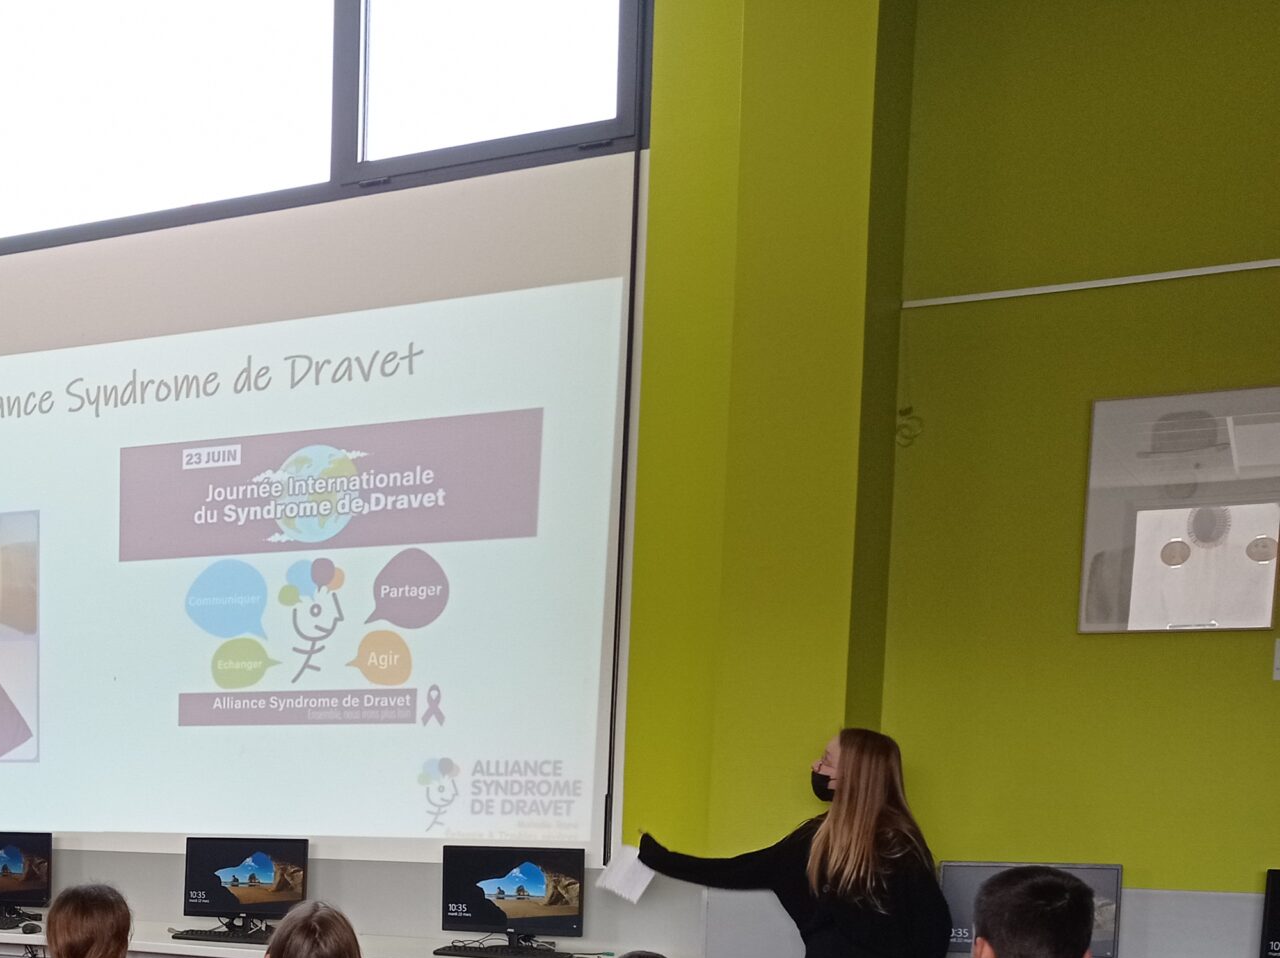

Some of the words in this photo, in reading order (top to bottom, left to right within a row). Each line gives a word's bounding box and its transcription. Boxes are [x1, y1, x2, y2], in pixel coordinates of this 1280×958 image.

[65, 368, 221, 418] Syndrome
[233, 354, 272, 394] de
[283, 341, 425, 390] Dravet
[184, 452, 202, 466] 23
[204, 448, 238, 464] JUIN
[205, 480, 282, 503] Journée
[286, 465, 435, 497] Internationale
[194, 505, 219, 525] du
[223, 496, 332, 526] Syndrome
[370, 488, 447, 512] Dravet
[380, 584, 443, 600] Partager
[367, 651, 400, 670] Agir
[213, 695, 266, 710] Alliance
[270, 694, 340, 712] Syndrome
[342, 693, 360, 708] de
[363, 693, 412, 708] Dravet
[471, 759, 563, 777] ALLIANCE
[470, 779, 583, 797] SYNDROME
[470, 799, 496, 816] DE
[500, 799, 575, 816] DRAVET
[189, 890, 206, 899] 10:35
[448, 903, 468, 912] 10:35
[950, 928, 969, 938] :35
